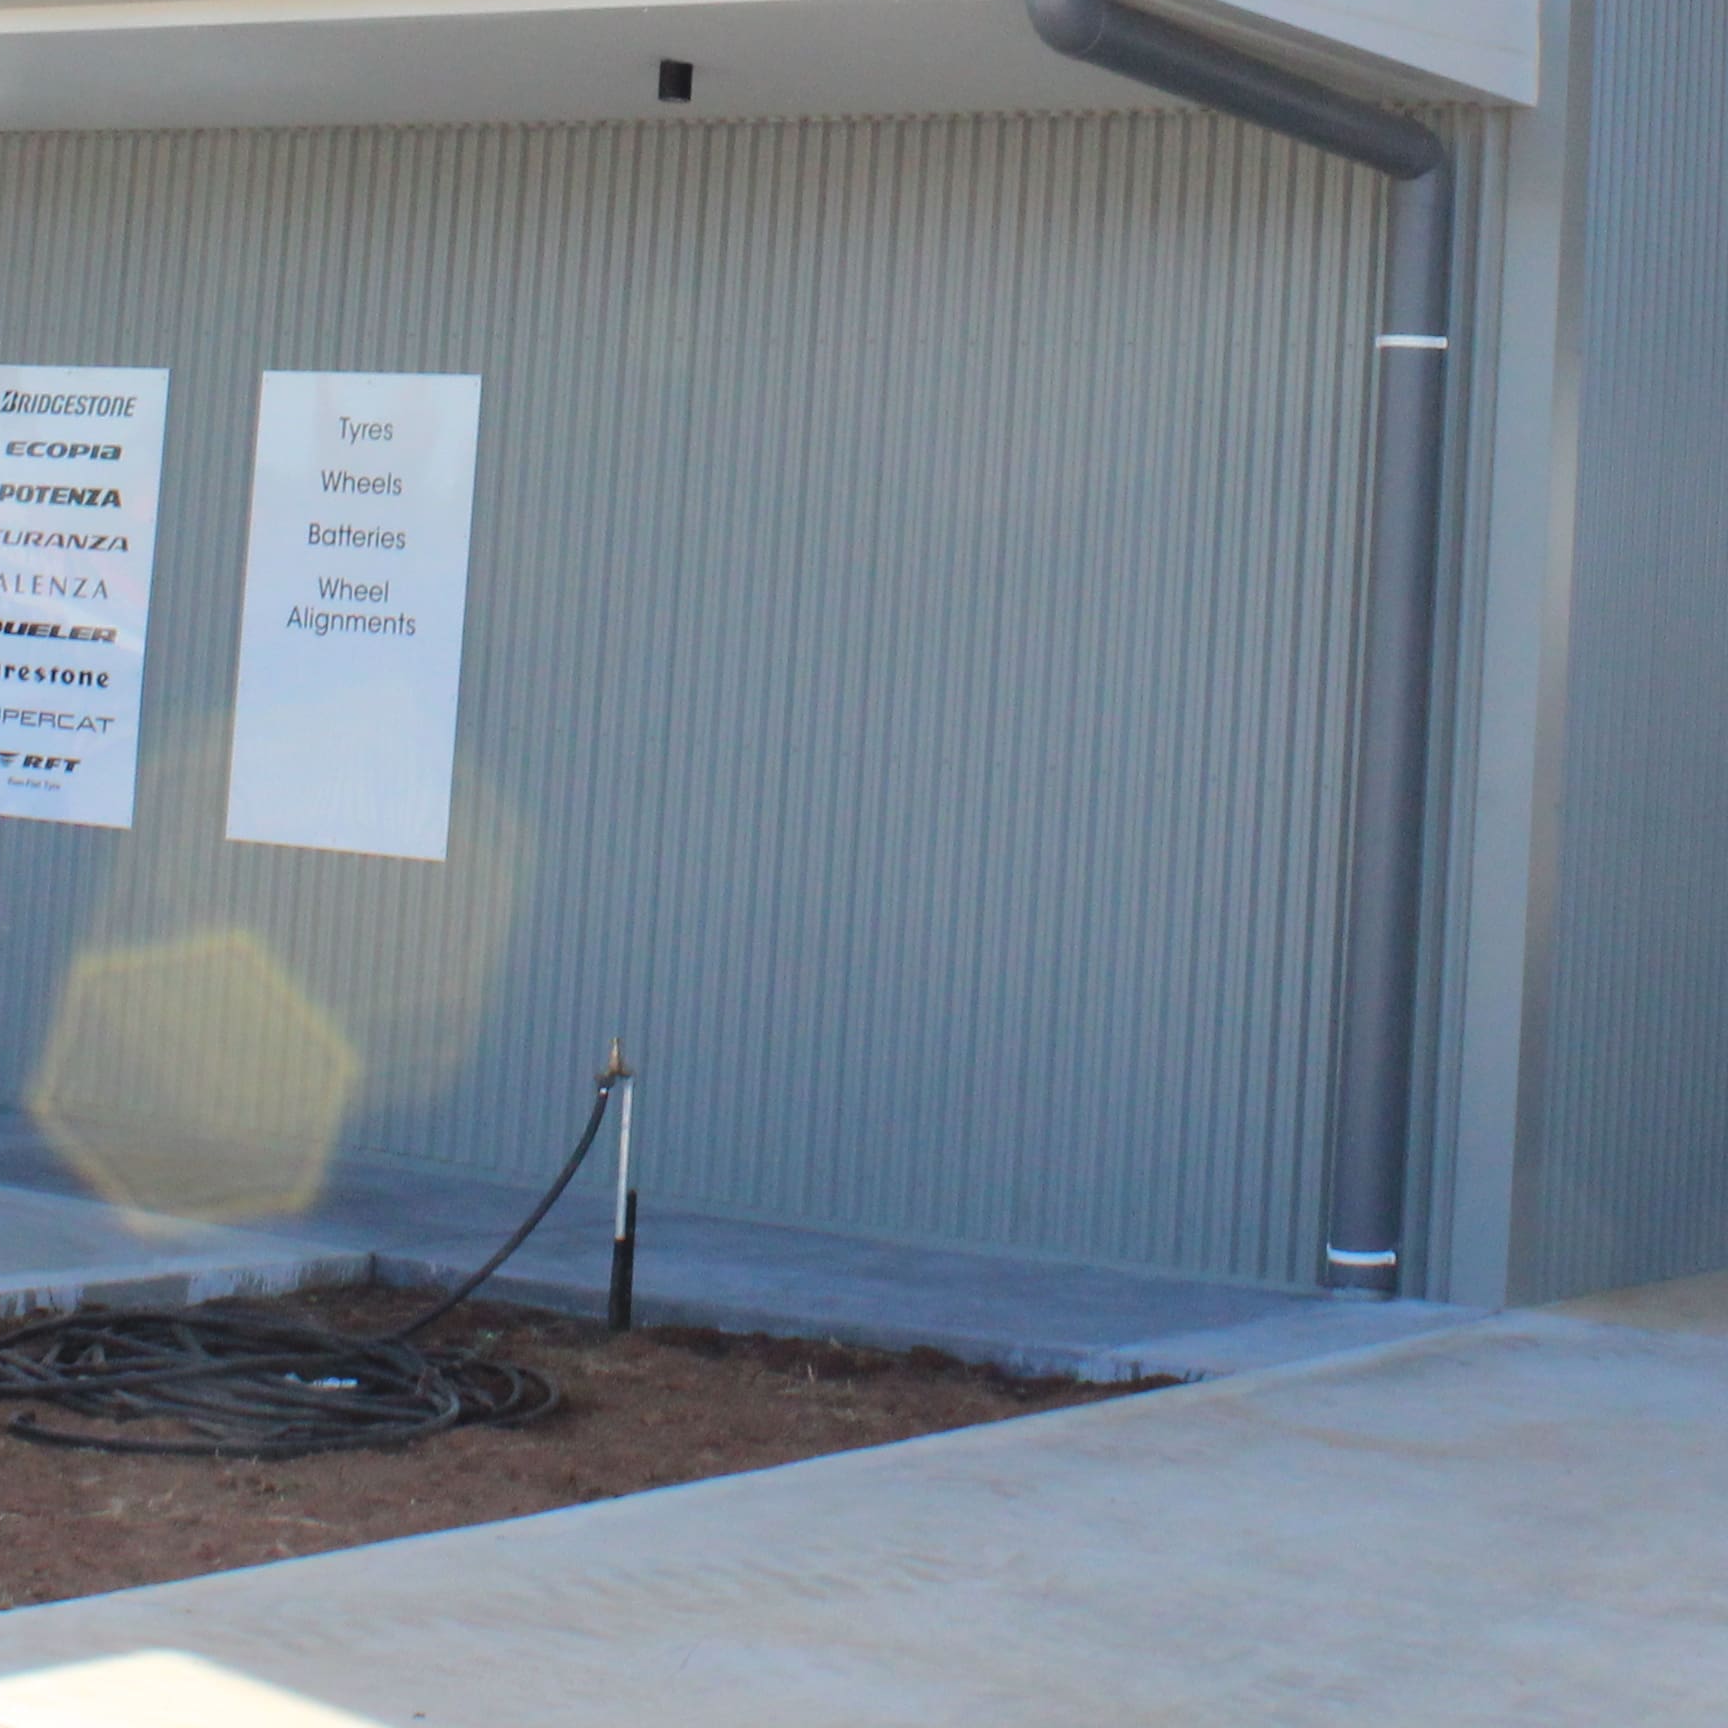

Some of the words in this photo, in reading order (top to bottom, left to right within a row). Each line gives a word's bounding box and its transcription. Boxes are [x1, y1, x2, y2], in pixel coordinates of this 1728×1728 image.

[0, 389, 137, 418] BRIDGESTONE
[339, 416, 393, 445] Tyres
[321, 470, 403, 496] Wheels
[308, 522, 406, 550] Batteries
[319, 575, 390, 603] Wheel
[286, 605, 416, 636] Alignments
[22, 754, 81, 773] RFT
